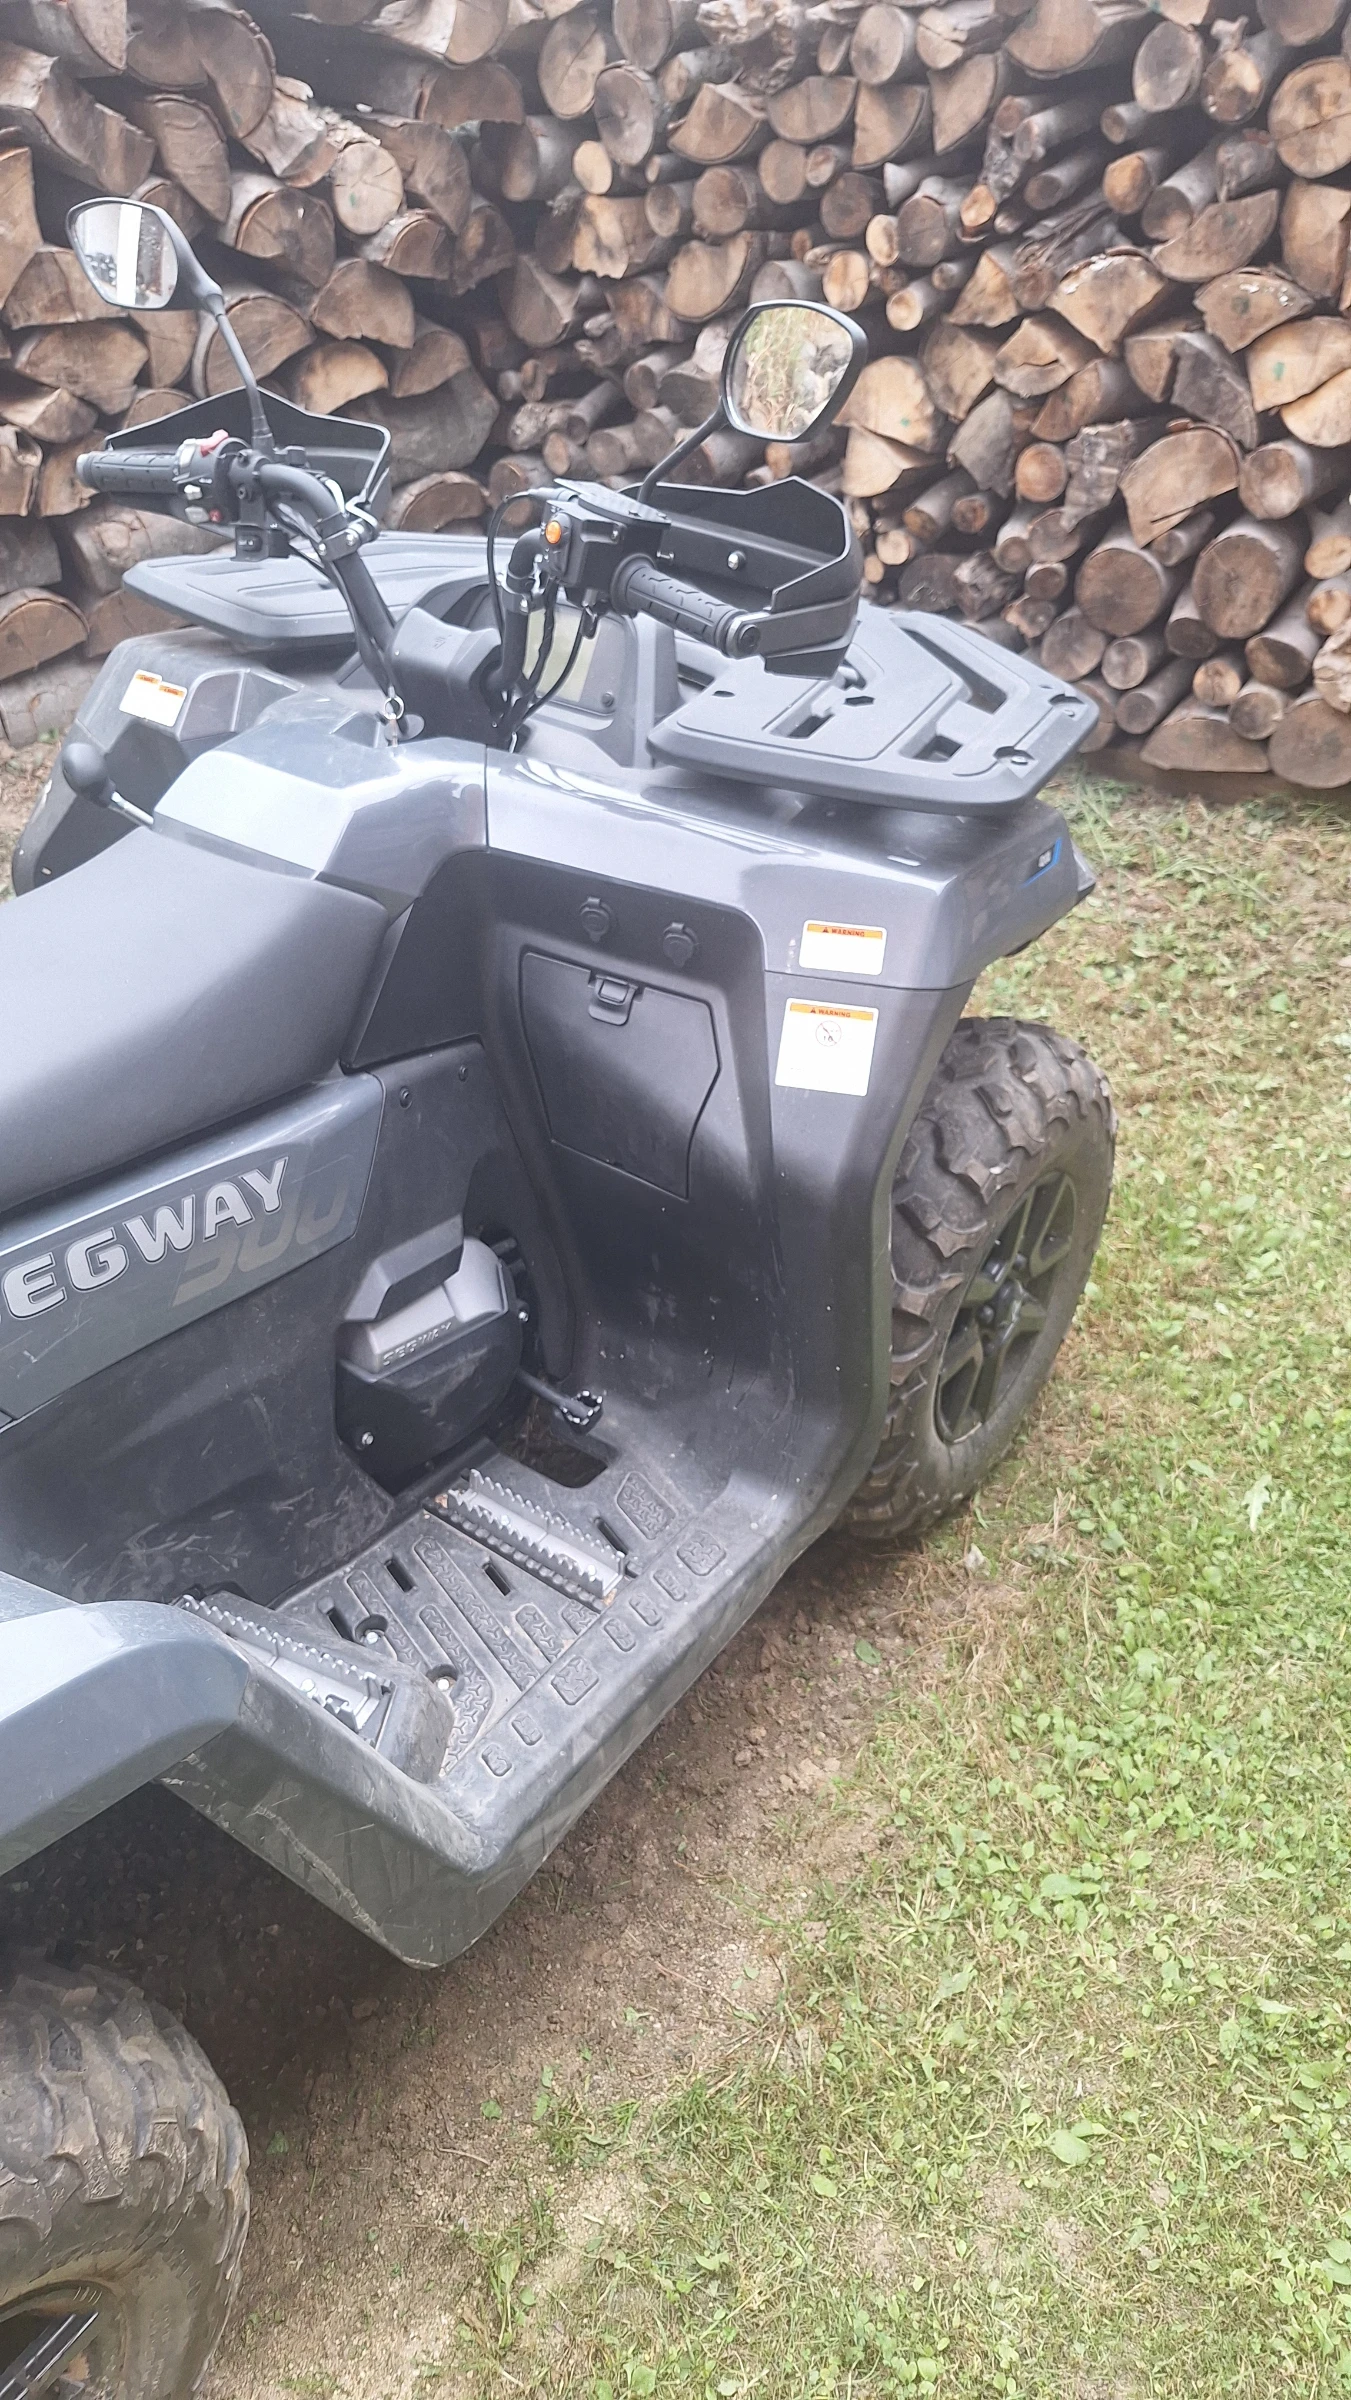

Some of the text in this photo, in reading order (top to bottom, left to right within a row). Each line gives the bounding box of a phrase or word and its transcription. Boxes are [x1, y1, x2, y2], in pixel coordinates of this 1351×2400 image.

[831, 927, 865, 938] WARNING
[818, 1007, 851, 1019] WARNING
[0, 1157, 289, 1323] EGWAY
